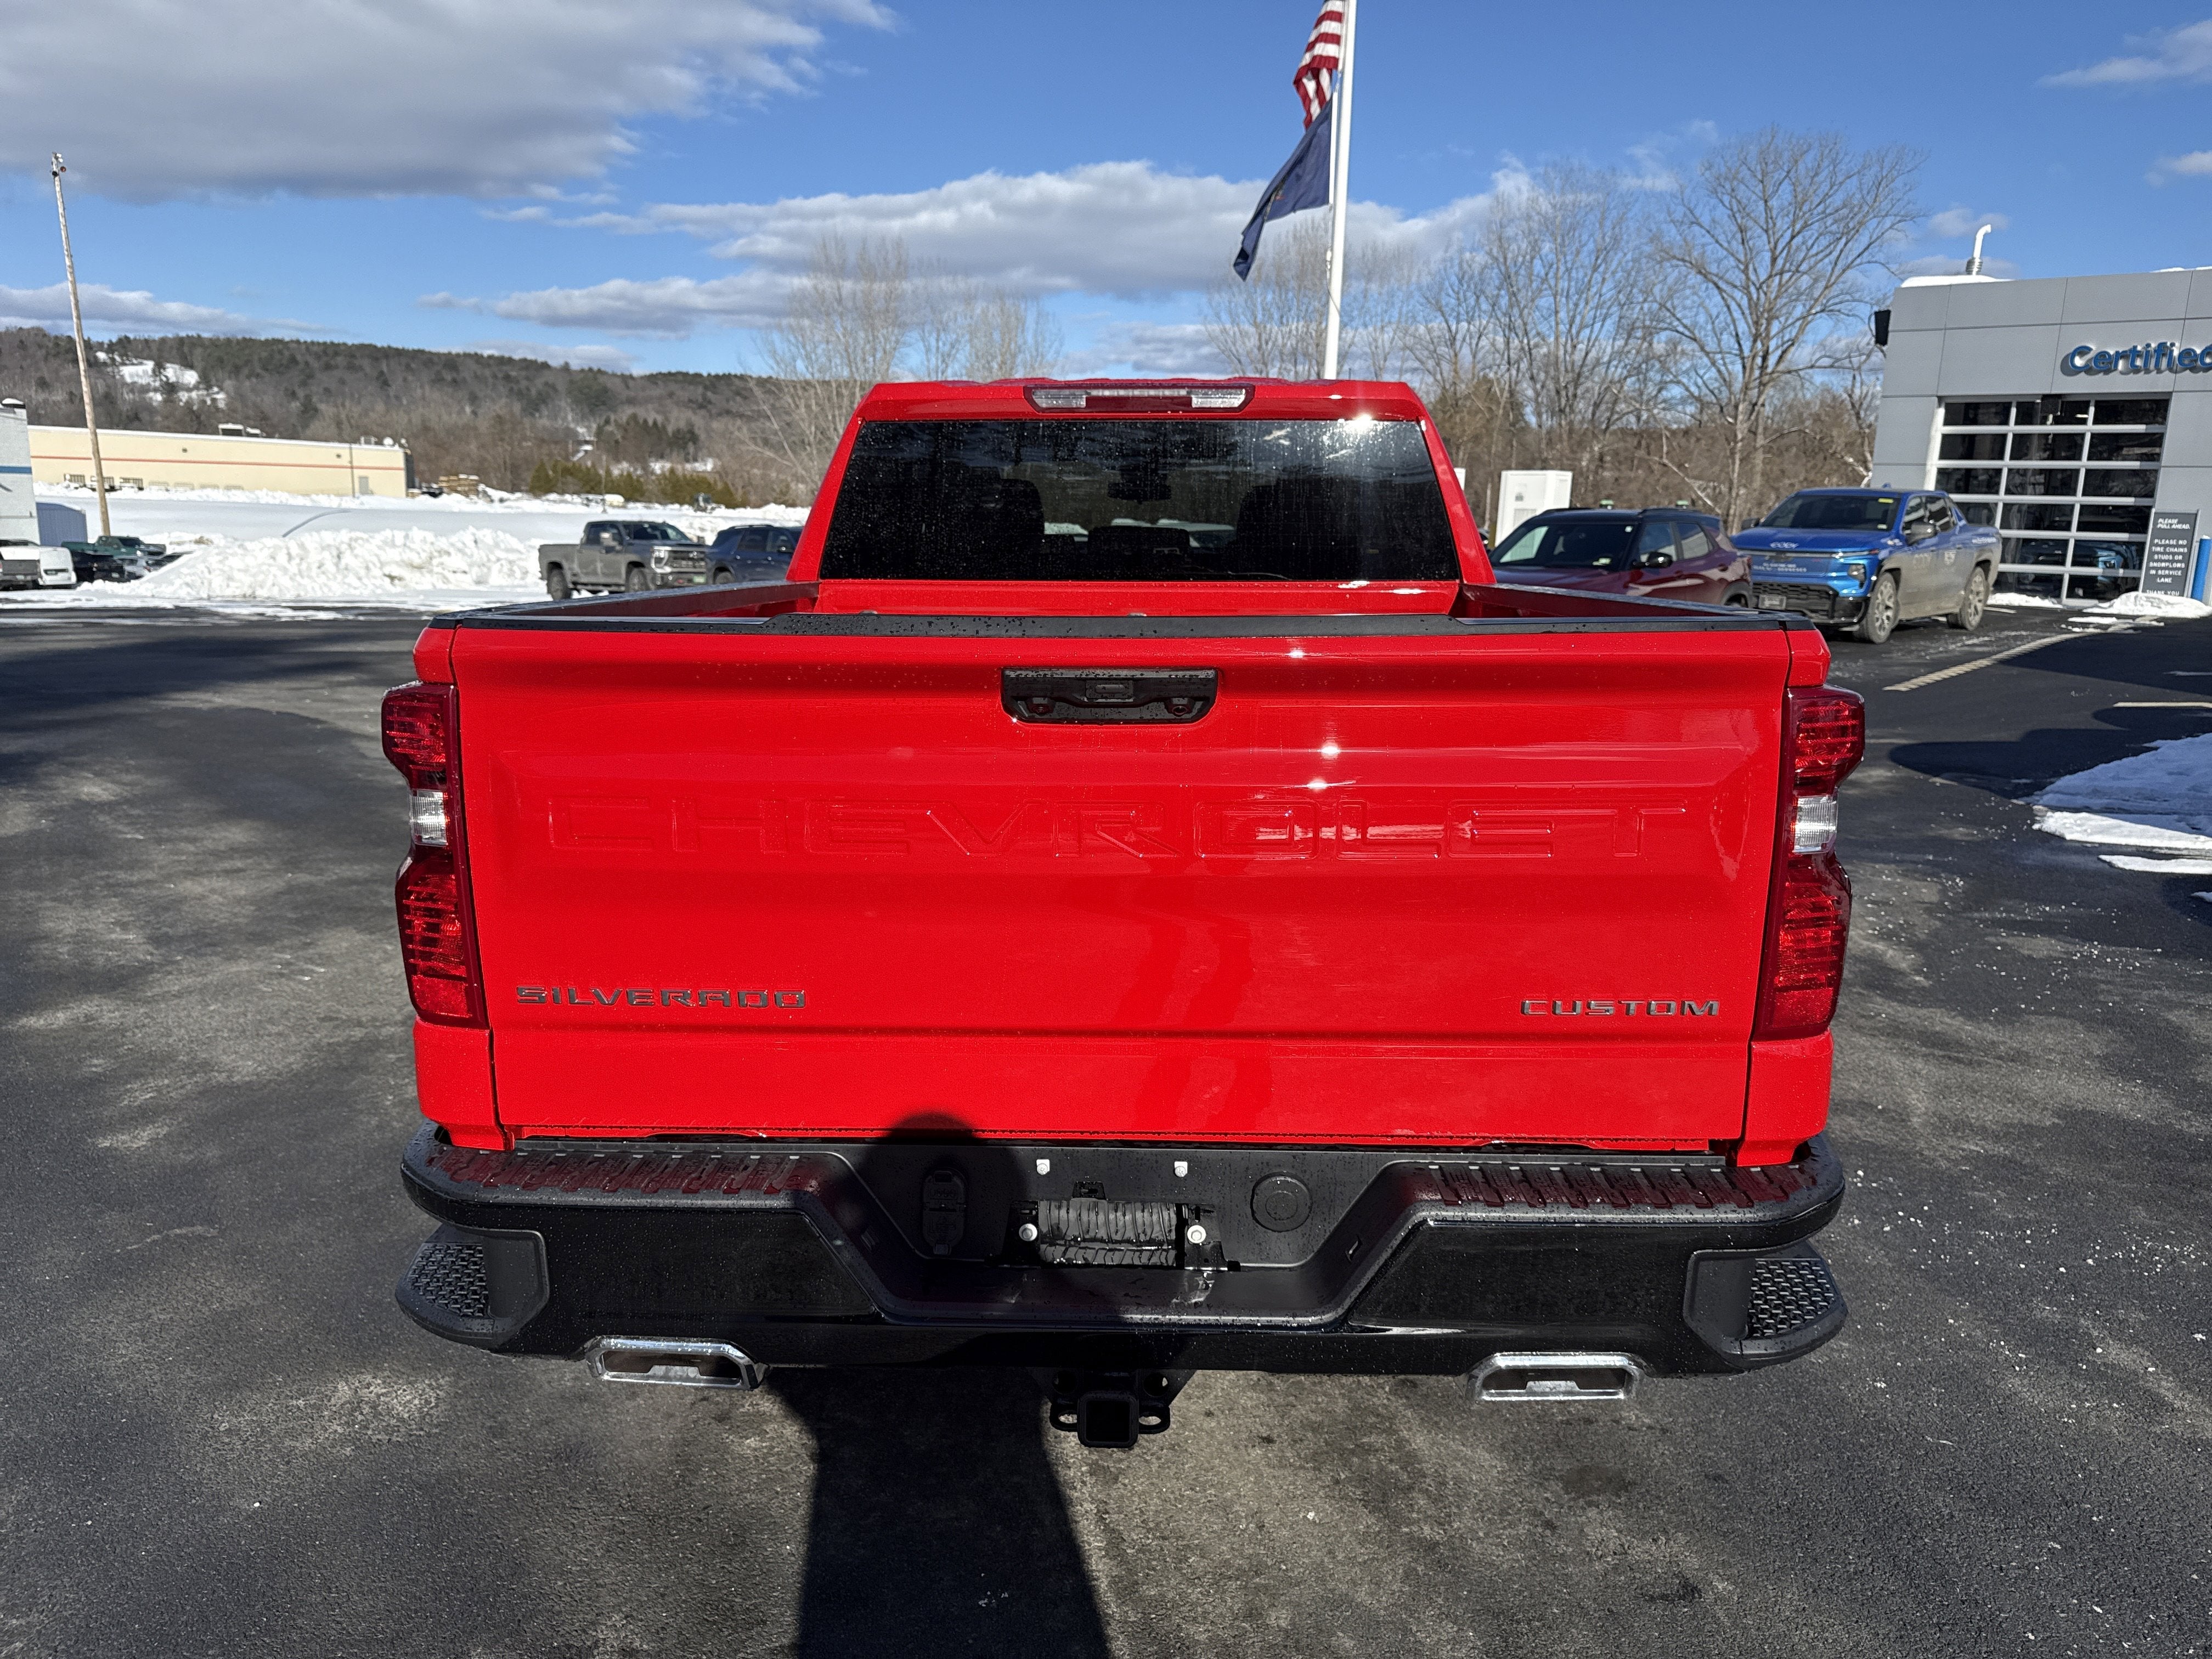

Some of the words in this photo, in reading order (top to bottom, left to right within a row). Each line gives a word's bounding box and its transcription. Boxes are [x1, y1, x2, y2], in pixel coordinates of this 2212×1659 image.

[548, 797, 1687, 860] CHEVROLET
[516, 985, 806, 1008] SILVERADO
[1520, 1000, 1720, 1017] CUSTOM
